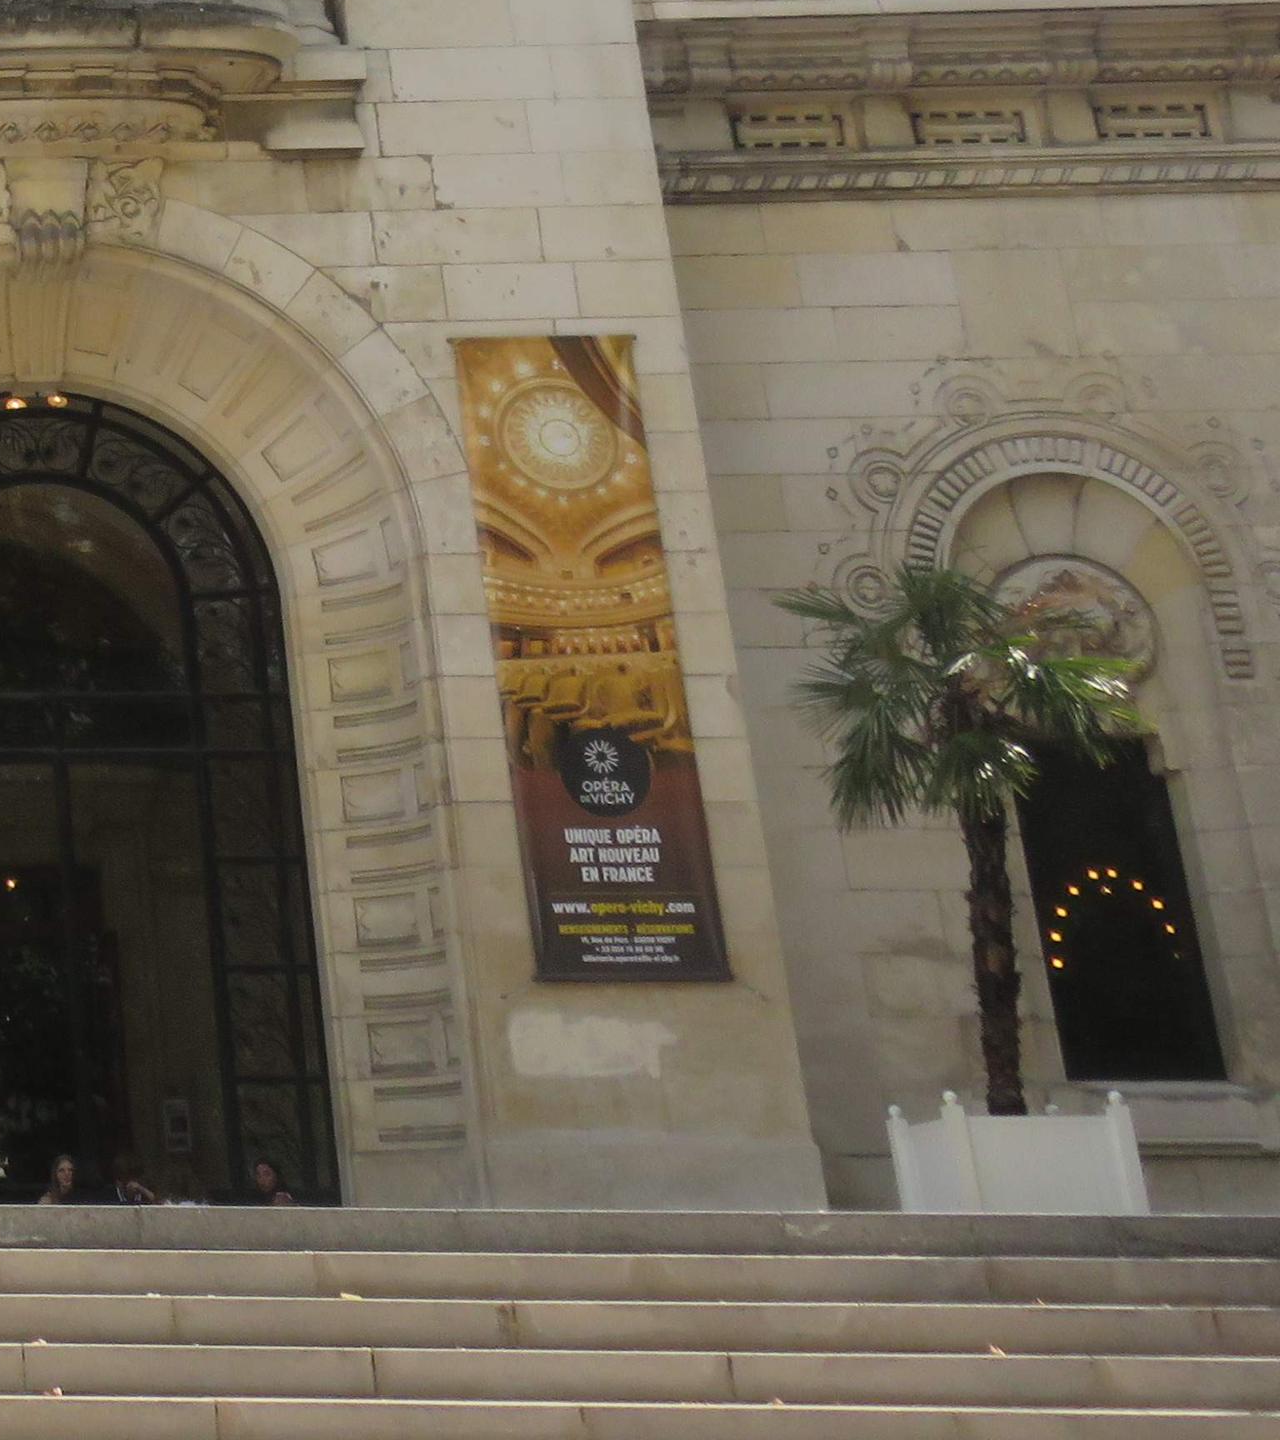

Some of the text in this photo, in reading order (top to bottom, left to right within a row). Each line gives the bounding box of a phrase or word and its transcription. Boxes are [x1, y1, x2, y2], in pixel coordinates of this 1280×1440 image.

[582, 778, 631, 793] OPÉRA
[591, 793, 635, 805] VICHY
[564, 825, 662, 845] UNIQUE OPÉRA
[570, 848, 660, 863] ART NOUVEAU
[581, 867, 655, 882] EN FRANCE
[552, 901, 695, 916] www.opera-vichy.com
